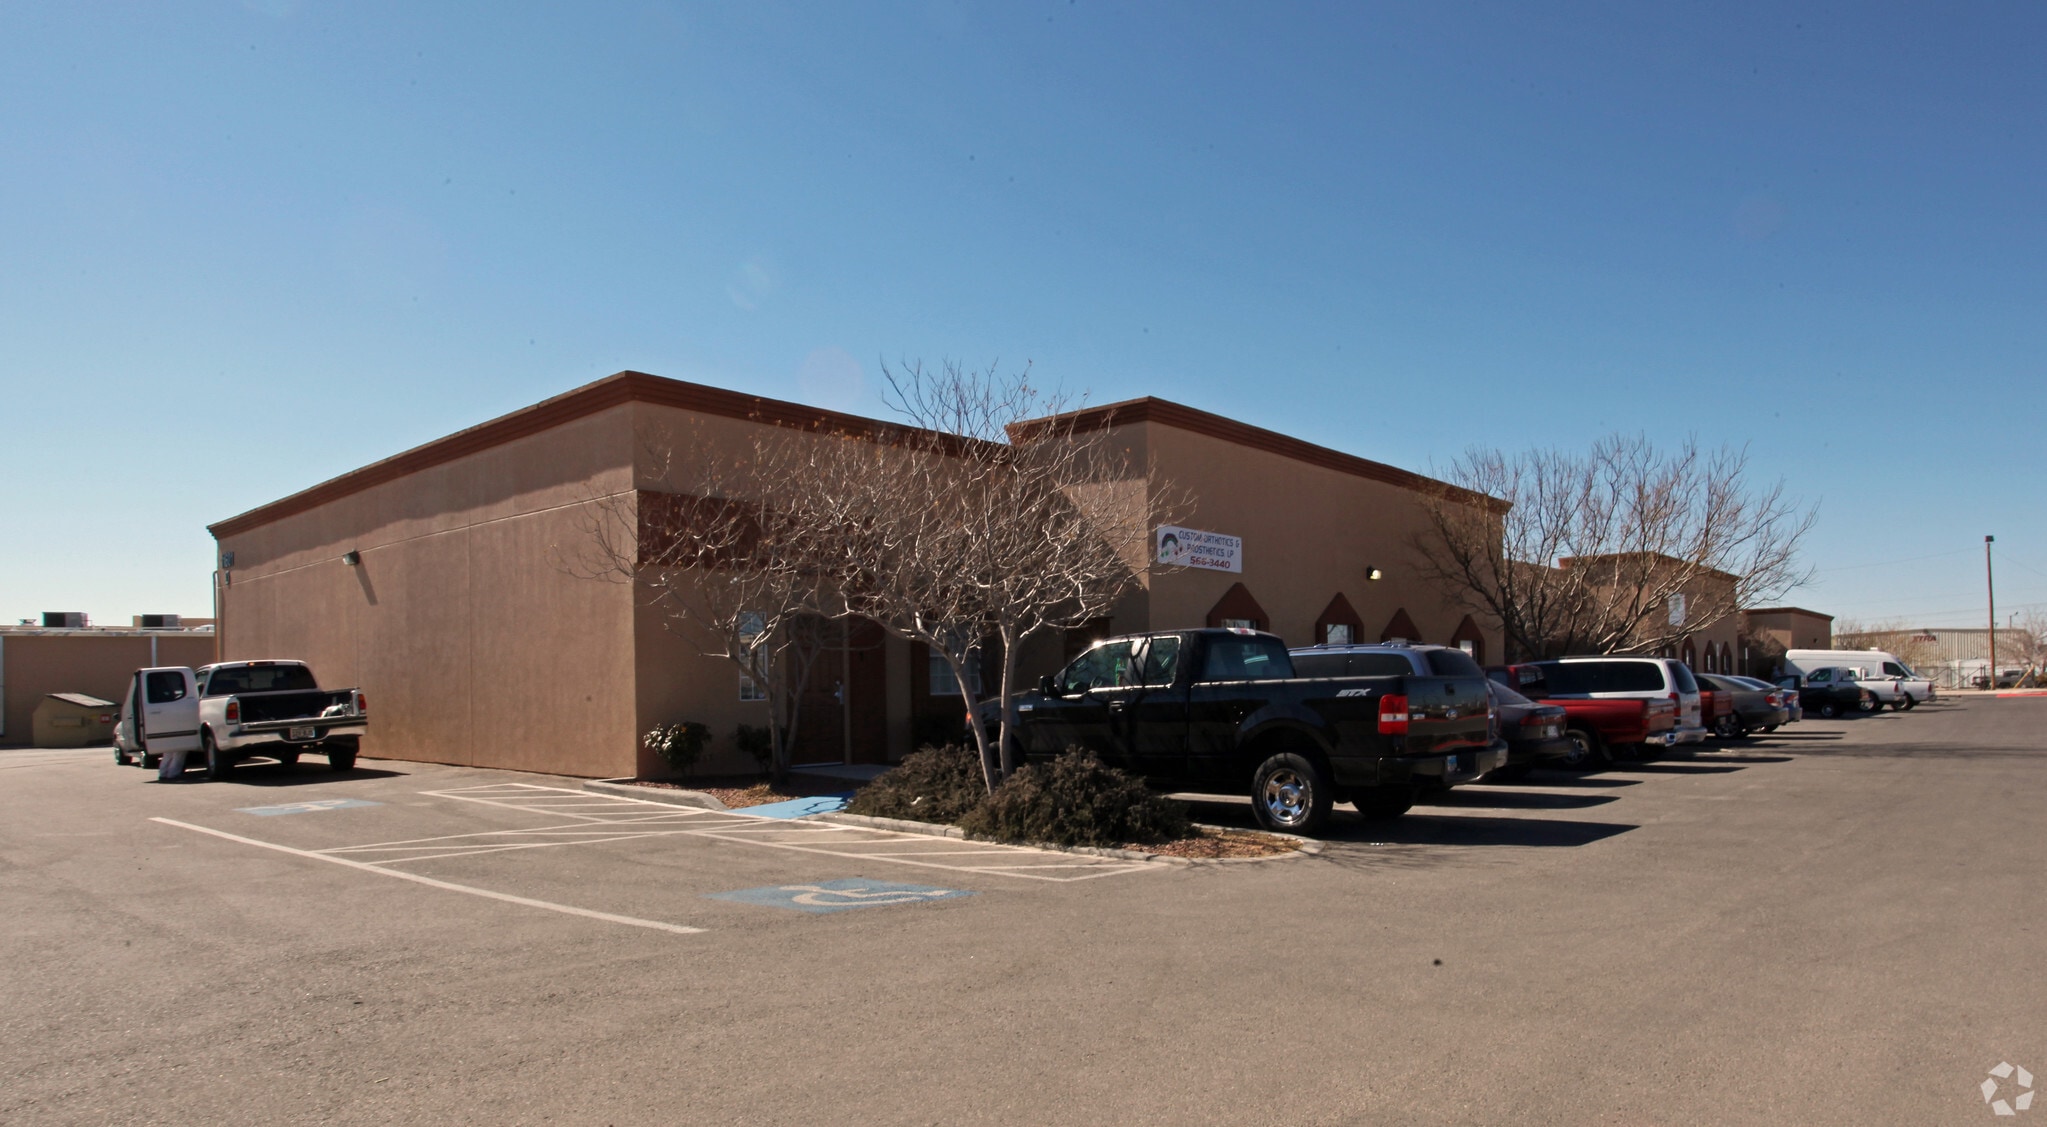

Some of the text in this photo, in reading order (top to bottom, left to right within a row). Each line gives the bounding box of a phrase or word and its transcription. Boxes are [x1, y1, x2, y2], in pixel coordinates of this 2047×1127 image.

[1179, 530, 1202, 542] CUSTOM
[1203, 535, 1234, 547] ORTHOTICS
[1227, 550, 1234, 558] LP
[1190, 556, 1231, 569] 566-3440
[1335, 688, 1371, 697] STX
